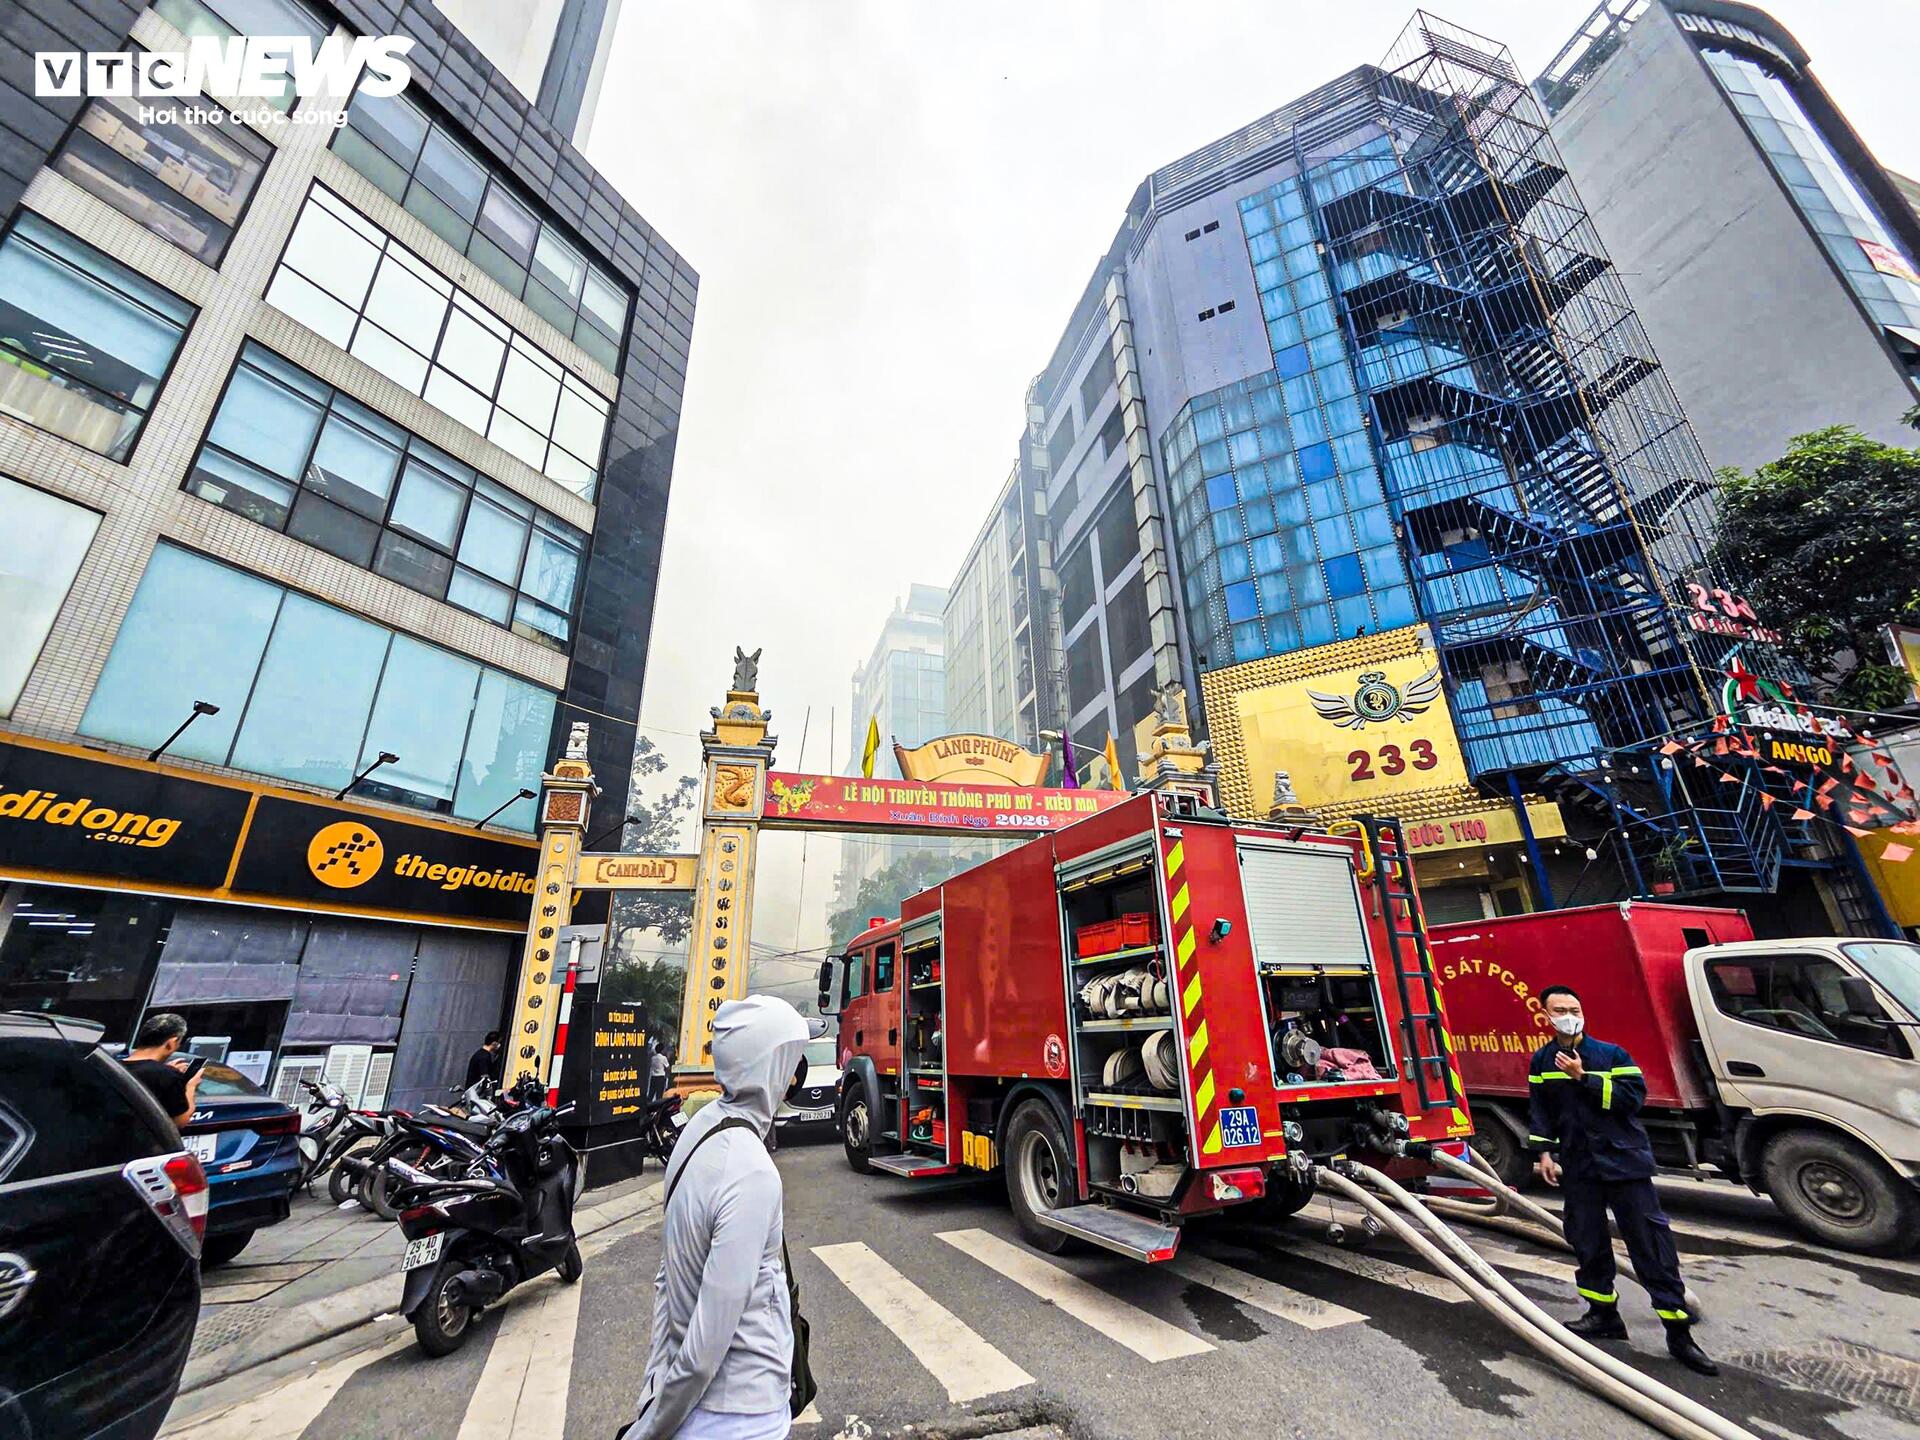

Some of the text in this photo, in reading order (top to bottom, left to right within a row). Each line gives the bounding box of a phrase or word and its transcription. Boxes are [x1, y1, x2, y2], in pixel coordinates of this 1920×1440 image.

[934, 737, 971, 759] LÀNG
[1347, 739, 1438, 781] 233
[1772, 741, 1833, 765] AMIGO
[844, 781, 858, 802] LỄ
[862, 785, 885, 805] HỘI
[888, 785, 937, 807] TRUYỀN
[941, 787, 983, 809] THỐNG
[986, 791, 1013, 810] PHÚ
[1015, 793, 1033, 811] MỸ
[1044, 791, 1072, 811] KIỀU
[1075, 798, 1098, 812] MAI
[0, 785, 182, 847] didong
[995, 814, 1050, 827] 2026
[85, 832, 136, 845] .com
[1408, 819, 1487, 848] ĐỨC THỌ
[1443, 956, 1482, 980] SÁT
[1469, 1028, 1499, 1052] PHỐ
[1501, 1031, 1525, 1053] HÀ
[1228, 1110, 1250, 1127] 29A
[1223, 1126, 1259, 1145] 026.12
[403, 1248, 436, 1269] 304.78
